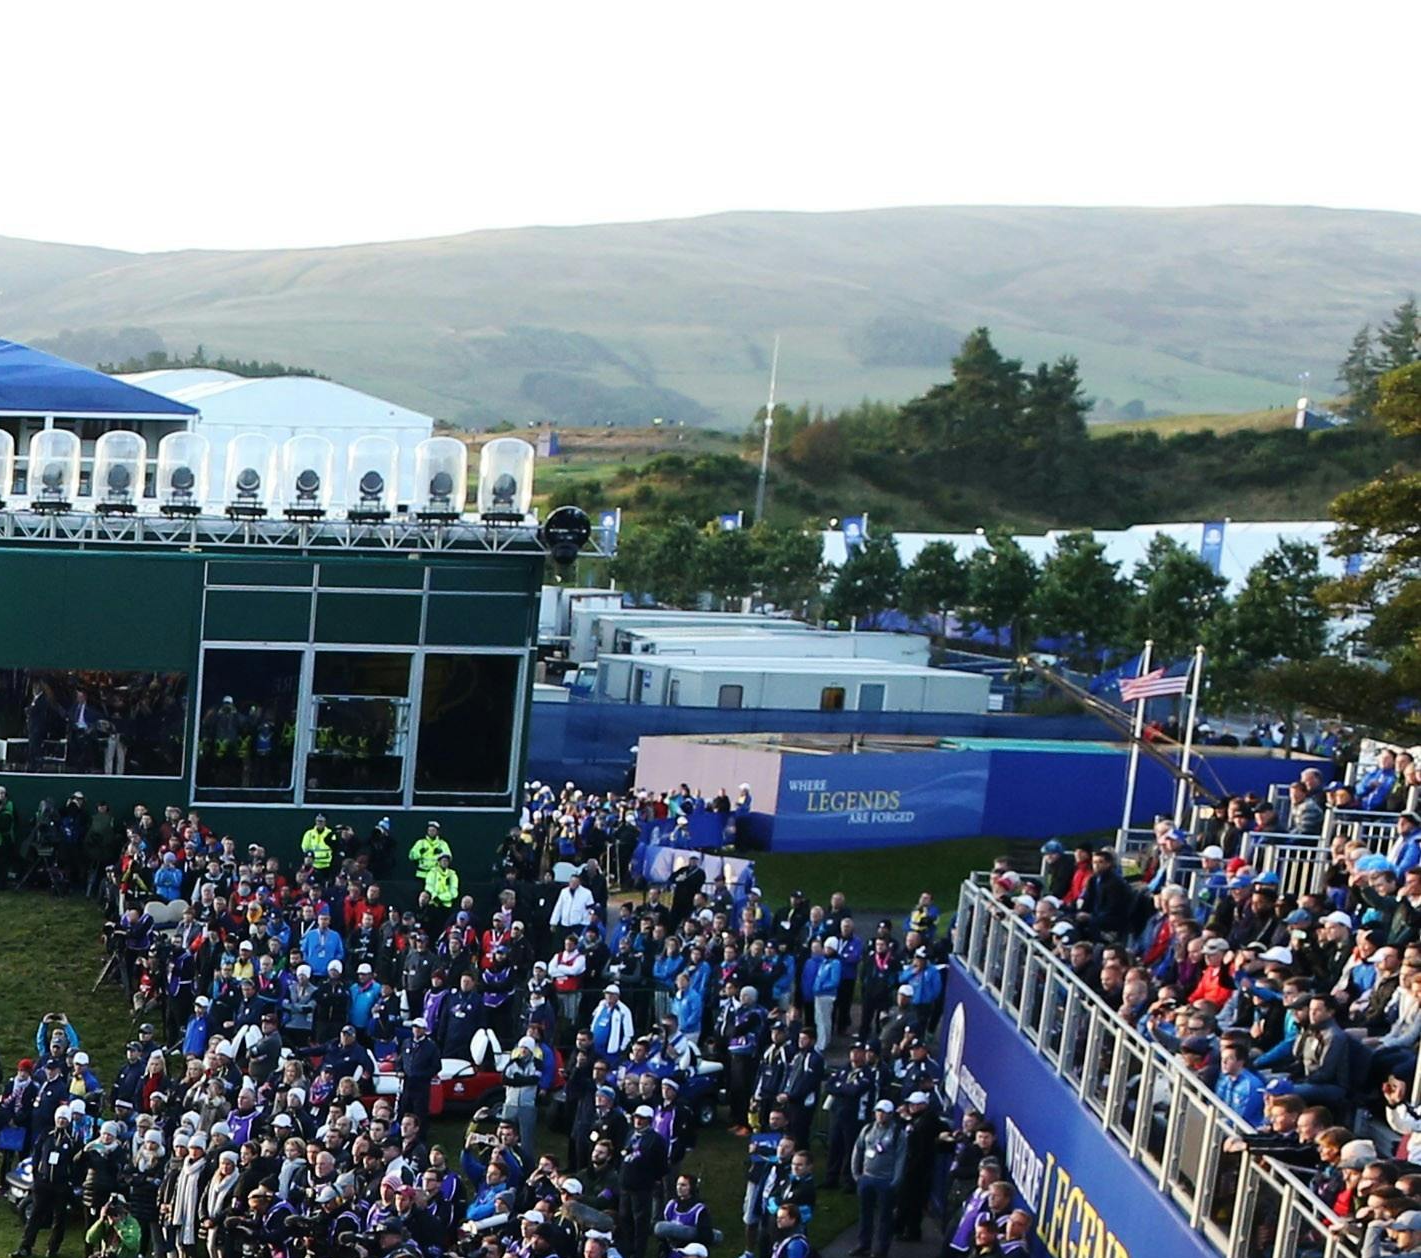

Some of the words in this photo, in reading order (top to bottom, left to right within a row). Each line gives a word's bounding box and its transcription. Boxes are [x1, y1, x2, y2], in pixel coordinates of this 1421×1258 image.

[789, 779, 827, 792] WHERE
[807, 790, 902, 812] LEGENDS
[848, 811, 869, 824] ARE
[871, 811, 915, 824] FORGED
